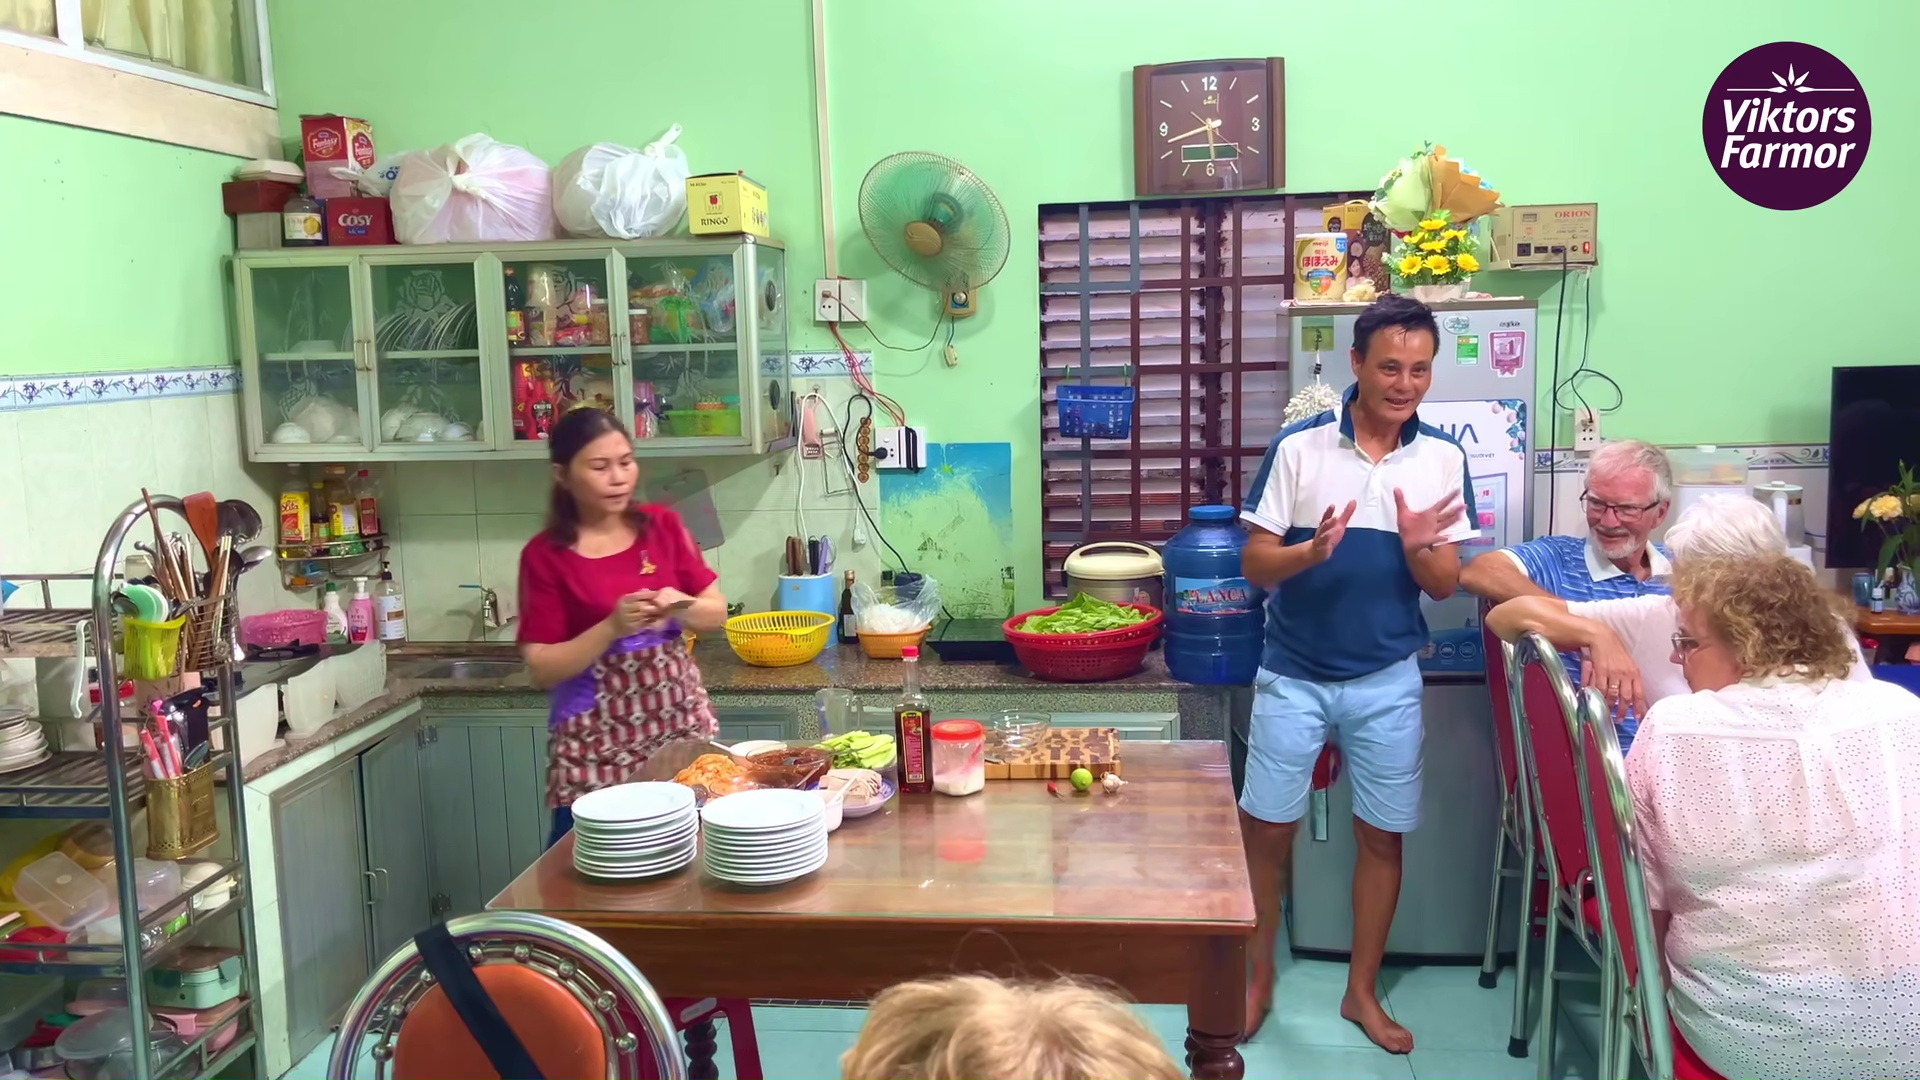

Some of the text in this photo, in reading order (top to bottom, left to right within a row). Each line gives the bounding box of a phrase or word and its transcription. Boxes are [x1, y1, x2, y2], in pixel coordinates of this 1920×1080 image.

[1201, 75, 1218, 91] 12
[1159, 121, 1169, 137] 9
[1251, 117, 1261, 132] 3
[1205, 162, 1216, 176] 6
[338, 213, 373, 226] COSY
[1554, 210, 1592, 218] ORION
[700, 217, 729, 226] RINGO
[1302, 255, 1339, 268] ほほえみ
